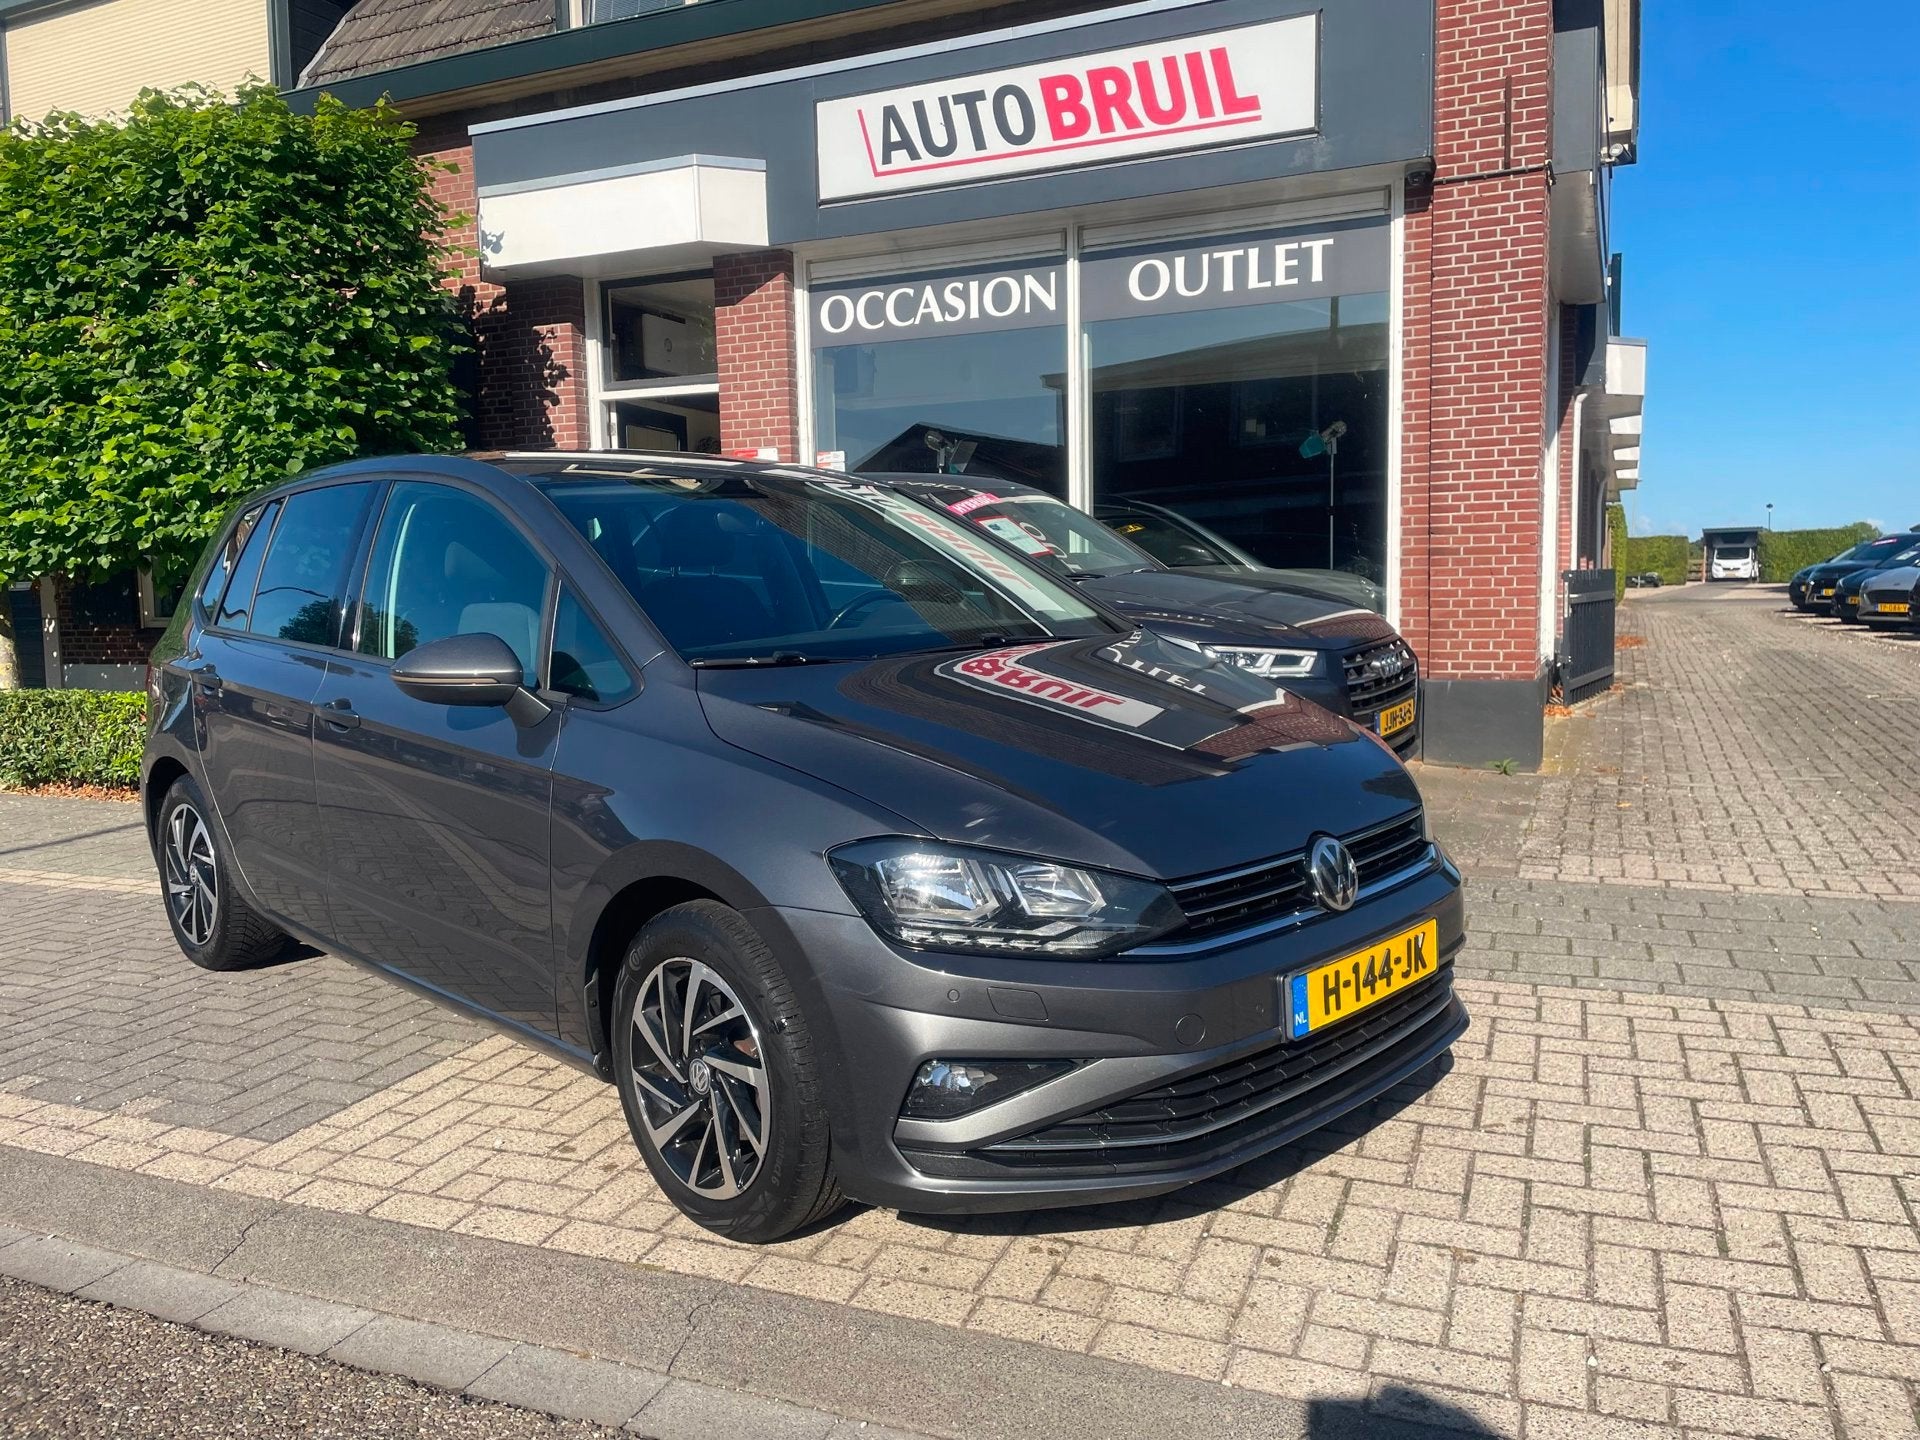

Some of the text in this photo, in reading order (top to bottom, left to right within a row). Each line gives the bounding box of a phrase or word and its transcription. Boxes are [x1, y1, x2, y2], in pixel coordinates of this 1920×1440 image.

[881, 47, 1261, 165] AUTO BRUIL
[820, 238, 1334, 333] OCCASION OUTLET
[1323, 932, 1428, 1015] H-144-JK
[1295, 1012, 1307, 1026] NL
